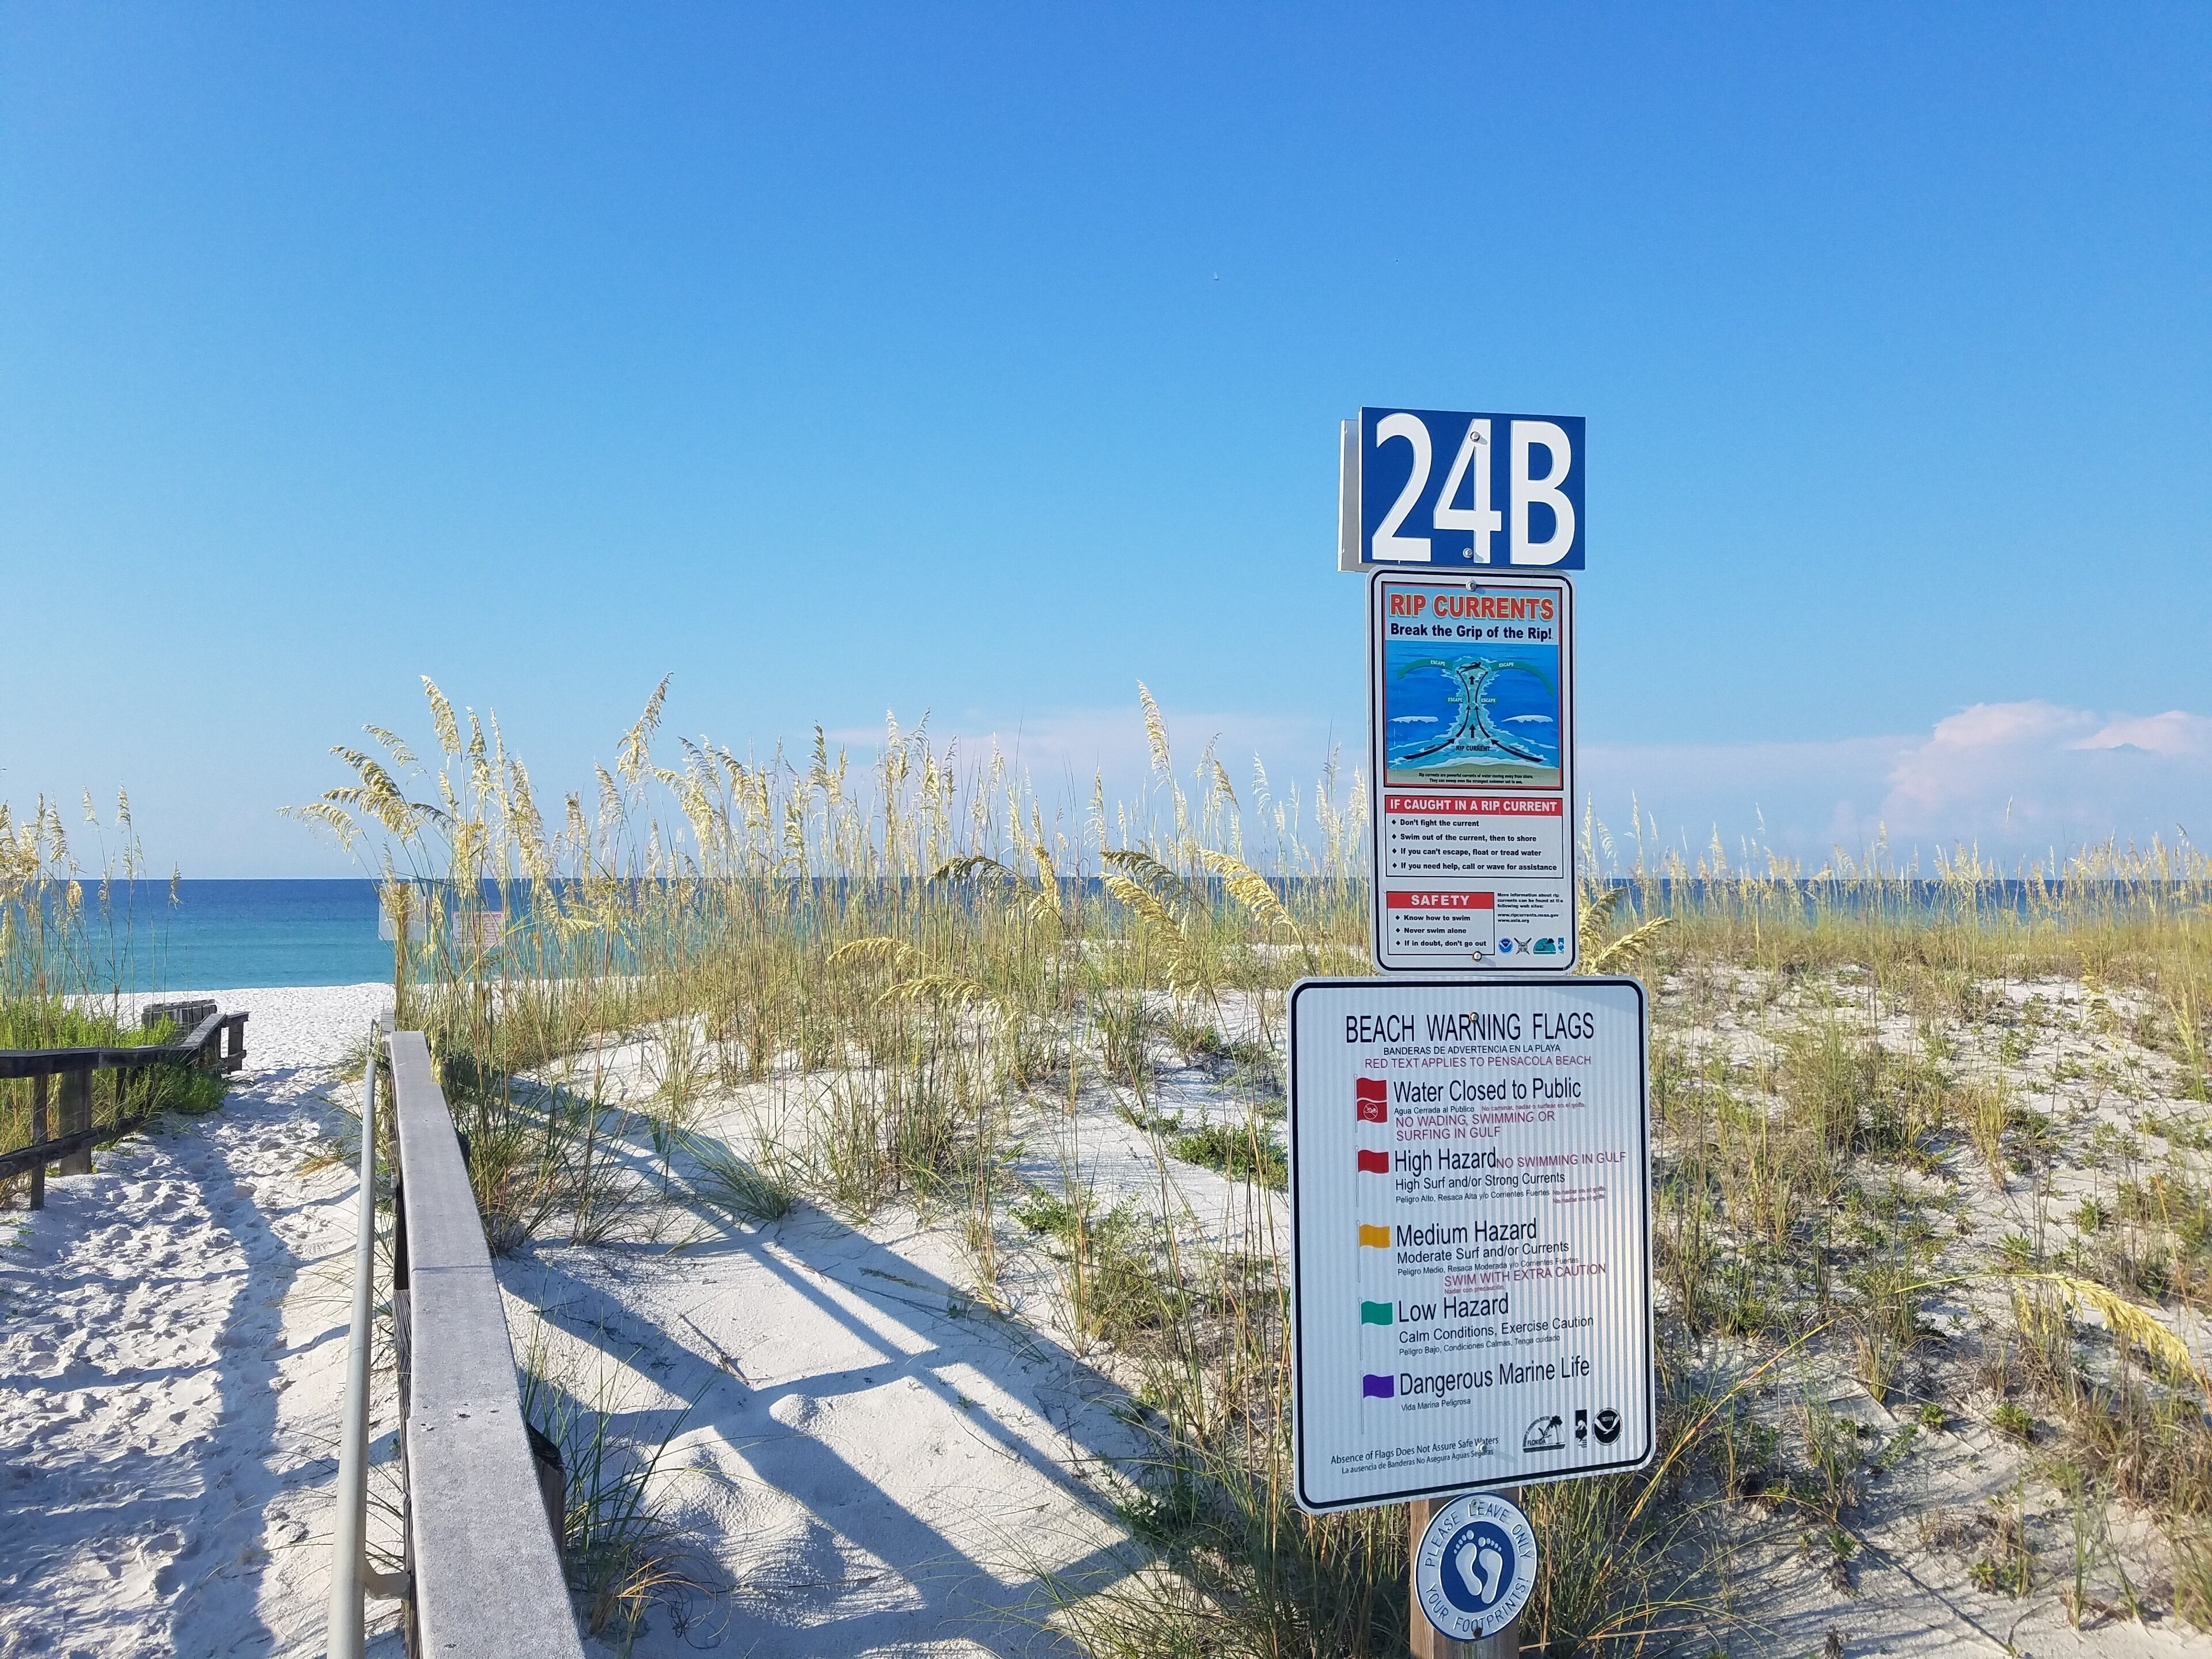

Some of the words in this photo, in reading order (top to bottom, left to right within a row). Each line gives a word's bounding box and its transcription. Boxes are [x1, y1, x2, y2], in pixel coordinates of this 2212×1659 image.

[1372, 412, 1575, 565] 24B
[1389, 593, 1426, 616] RIP
[1433, 594, 1554, 620] CURRENTS
[1391, 623, 1427, 635] Break
[1432, 625, 1452, 637] the
[1457, 626, 1482, 640] Grip
[1487, 627, 1499, 638] of
[1503, 627, 1523, 638] the
[1528, 627, 1551, 642] Rip!
[1390, 799, 1400, 809] IF
[1404, 800, 1451, 810] CAUGHT
[1455, 800, 1467, 810] IN
[1470, 801, 1478, 810] A
[1482, 801, 1500, 811] RIP
[1503, 801, 1556, 812] CURRENT
[1442, 863, 1460, 871] help,
[1411, 895, 1469, 906] SAFETY
[1346, 1014, 1414, 1043] BEACH
[1427, 1012, 1521, 1041] WARNING
[1533, 1012, 1594, 1040] FLAGS
[1384, 1046, 1431, 1055] BANDERAS
[1434, 1046, 1446, 1054] DE
[1448, 1045, 1507, 1054] ADVERTENCIA
[1535, 1044, 1560, 1052] PLAYA
[1365, 1058, 1388, 1069] RED
[1392, 1058, 1420, 1068] TEXT
[1421, 1058, 1467, 1067] APPLIES
[1470, 1057, 1484, 1067] TO
[1488, 1056, 1552, 1066] PENSACOLA
[1556, 1055, 1591, 1065] BEACH
[1393, 1081, 1444, 1103] Water
[1449, 1079, 1506, 1101] Closed
[1512, 1080, 1527, 1099] to
[1533, 1077, 1581, 1099] Public
[1396, 1116, 1413, 1127] NO
[1418, 1115, 1468, 1126] WADING,
[1472, 1111, 1534, 1125] SWIMMING
[1538, 1111, 1555, 1122] OR
[1396, 1128, 1450, 1141] SURFING
[1455, 1128, 1465, 1139] IN
[1469, 1127, 1501, 1138] GULF
[1395, 1149, 1431, 1177] High
[1439, 1146, 1496, 1170] Hazard
[1497, 1158, 1513, 1169] NO
[1518, 1154, 1578, 1167] SWIMMING
[1582, 1154, 1592, 1164] IN
[1597, 1152, 1626, 1163] GULF
[1396, 1179, 1419, 1192] High
[1424, 1177, 1445, 1189] Surf
[1449, 1176, 1482, 1187] and/or
[1485, 1174, 1518, 1188] Strong
[1522, 1172, 1565, 1184] Currents
[1396, 1196, 1419, 1205] Peligro
[1479, 1192, 1488, 1200] y/o
[1397, 1223, 1468, 1247] Medium
[1475, 1218, 1537, 1242] Hazard
[1398, 1251, 1452, 1264] Moderate
[1456, 1247, 1479, 1259] Surf
[1483, 1245, 1519, 1257] and/or
[1522, 1241, 1569, 1255] Currents
[1445, 1274, 1476, 1287] SWIM
[1480, 1271, 1510, 1283] WITH
[1514, 1268, 1552, 1281] EXTRA
[1555, 1263, 1605, 1277] CAUTION
[1399, 1300, 1437, 1322] Low
[1444, 1292, 1509, 1319] Hazard
[1399, 1331, 1429, 1343] Calm
[1434, 1325, 1497, 1340] Conditions,
[1502, 1320, 1548, 1334] Exercise
[1552, 1316, 1593, 1330] Caution
[1400, 1370, 1493, 1397] Dangerous
[1500, 1361, 1555, 1385] Marine
[1562, 1355, 1589, 1378] Life
[1418, 1402, 1439, 1410] Marina
[1442, 1399, 1471, 1407] Peligrosa
[1331, 1454, 1363, 1464] Absence
[1365, 1450, 1373, 1460] of
[1375, 1450, 1394, 1460] Flags
[1396, 1448, 1415, 1456] Does
[1416, 1445, 1430, 1453] Not
[1432, 1444, 1456, 1452] Assure
[1458, 1439, 1473, 1448] Safe
[1350, 1463, 1377, 1473] ausencia
[1388, 1459, 1415, 1468] Banderas
[1452, 1453, 1469, 1461] Aguas
[1425, 1512, 1461, 1567] PLEASE
[1468, 1500, 1509, 1523] LEAVE
[1512, 1524, 1531, 1558] ONLY
[1426, 1584, 1449, 1622] YOUR
[1453, 1577, 1528, 1633] FOOTPRINTS!
